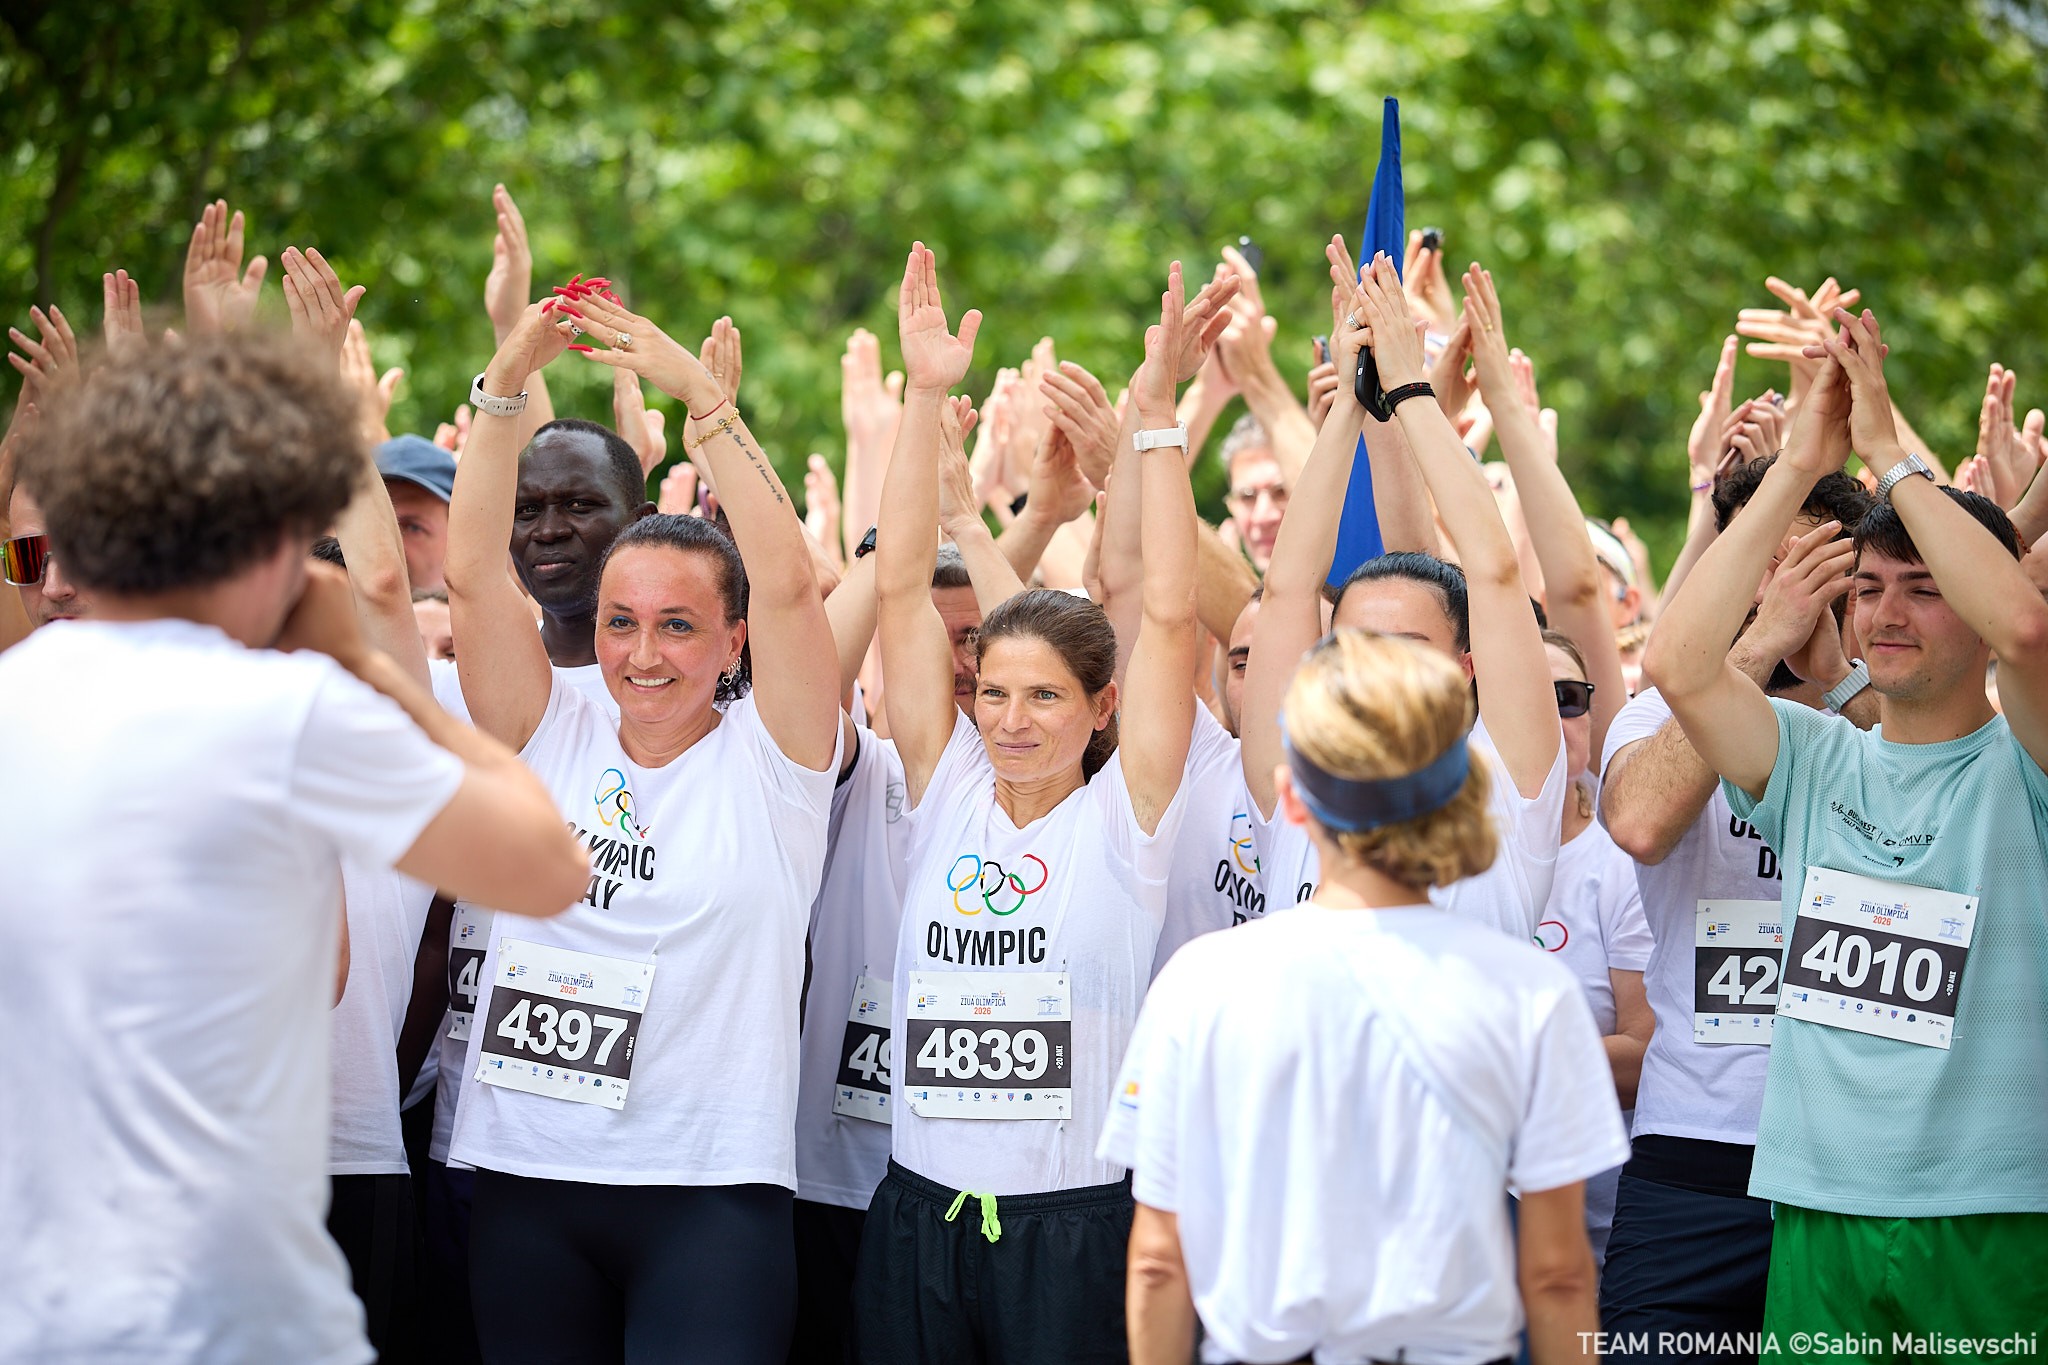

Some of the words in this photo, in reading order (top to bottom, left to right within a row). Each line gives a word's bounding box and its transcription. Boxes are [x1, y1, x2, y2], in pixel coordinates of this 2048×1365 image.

[1860, 903, 1875, 914] ZIUA
[1873, 915, 1892, 926] 2026
[1758, 925, 1775, 934] ZIUA
[926, 920, 1046, 966] OLYMPIC
[1800, 929, 1943, 1002] 4010
[547, 973, 562, 984] ZIUA
[559, 984, 577, 995] 2026
[960, 997, 975, 1006] ZIUA
[974, 1006, 992, 1015] 2026
[496, 998, 629, 1066] 4397
[916, 1027, 1049, 1080] 4839
